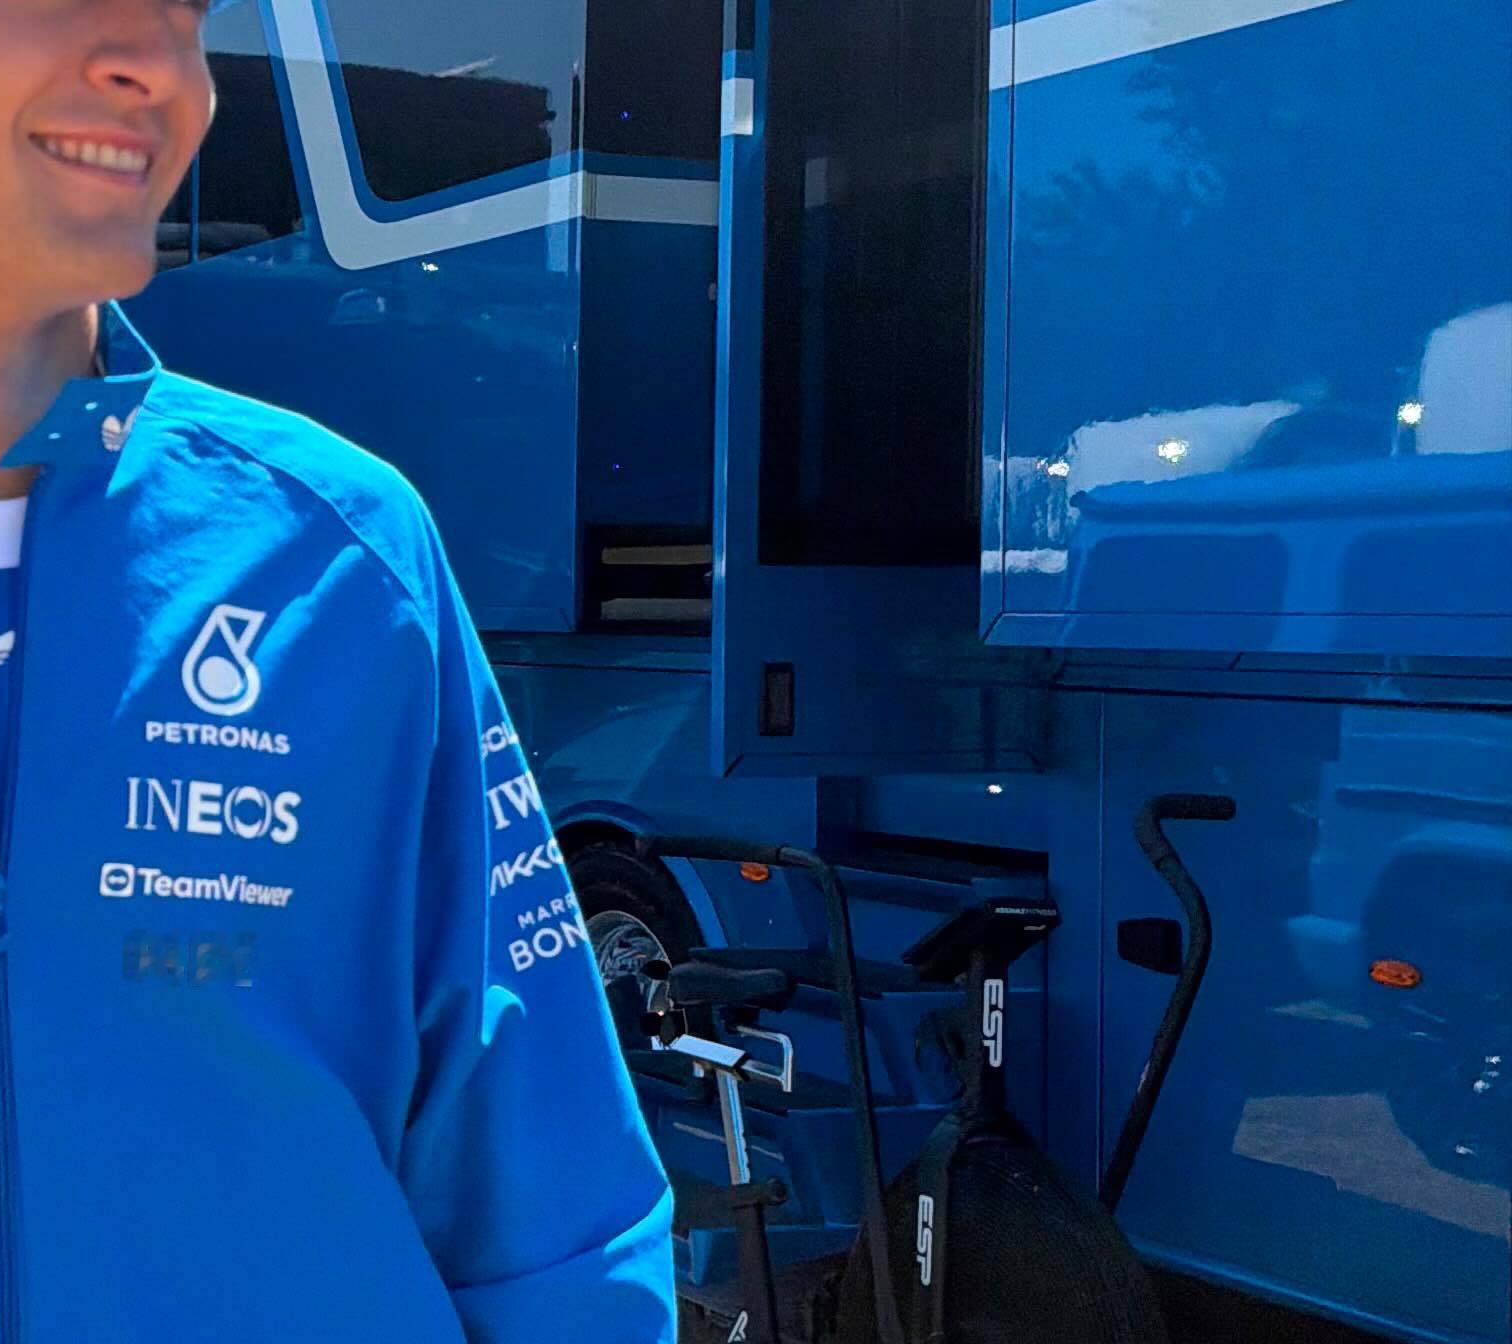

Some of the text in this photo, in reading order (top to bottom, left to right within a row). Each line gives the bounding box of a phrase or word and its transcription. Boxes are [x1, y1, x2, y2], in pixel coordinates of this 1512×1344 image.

[145, 721, 291, 755] PETRONAS
[124, 776, 302, 844] INEOS
[137, 867, 294, 908] TeamViewer
[982, 978, 1004, 1068] ESP
[916, 1194, 934, 1287] ESP
